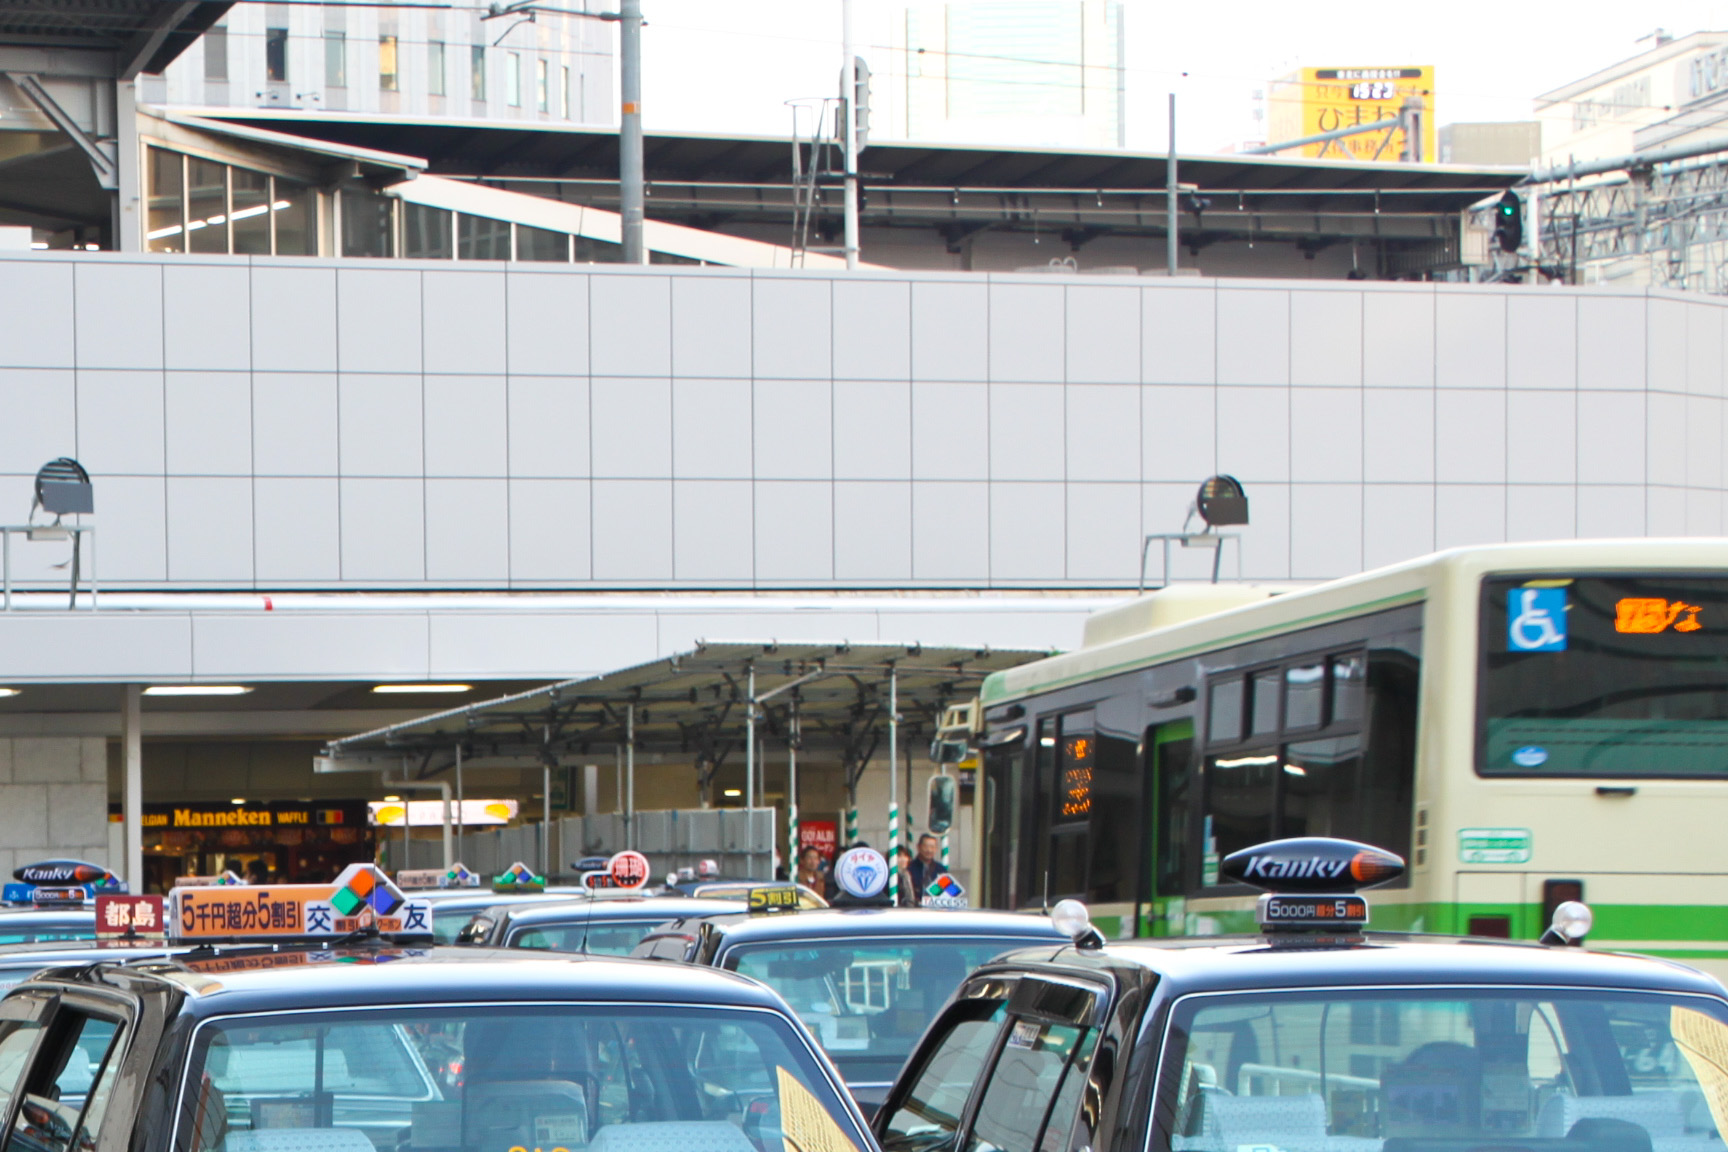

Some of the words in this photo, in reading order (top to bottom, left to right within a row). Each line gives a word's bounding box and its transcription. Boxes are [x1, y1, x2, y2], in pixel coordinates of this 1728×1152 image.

[141, 815, 168, 826] ELGIAN
[174, 809, 271, 827] Manneken
[277, 812, 308, 824] WAFFLE
[22, 868, 73, 880] Kanky
[1243, 856, 1348, 878] Kanky
[750, 889, 798, 907] 5割引
[104, 901, 156, 928] 都島
[182, 893, 302, 930] 5千円超分5割引
[308, 905, 332, 932] 交
[404, 903, 428, 930] 友
[1269, 900, 1365, 917] 5000円超分5割引
